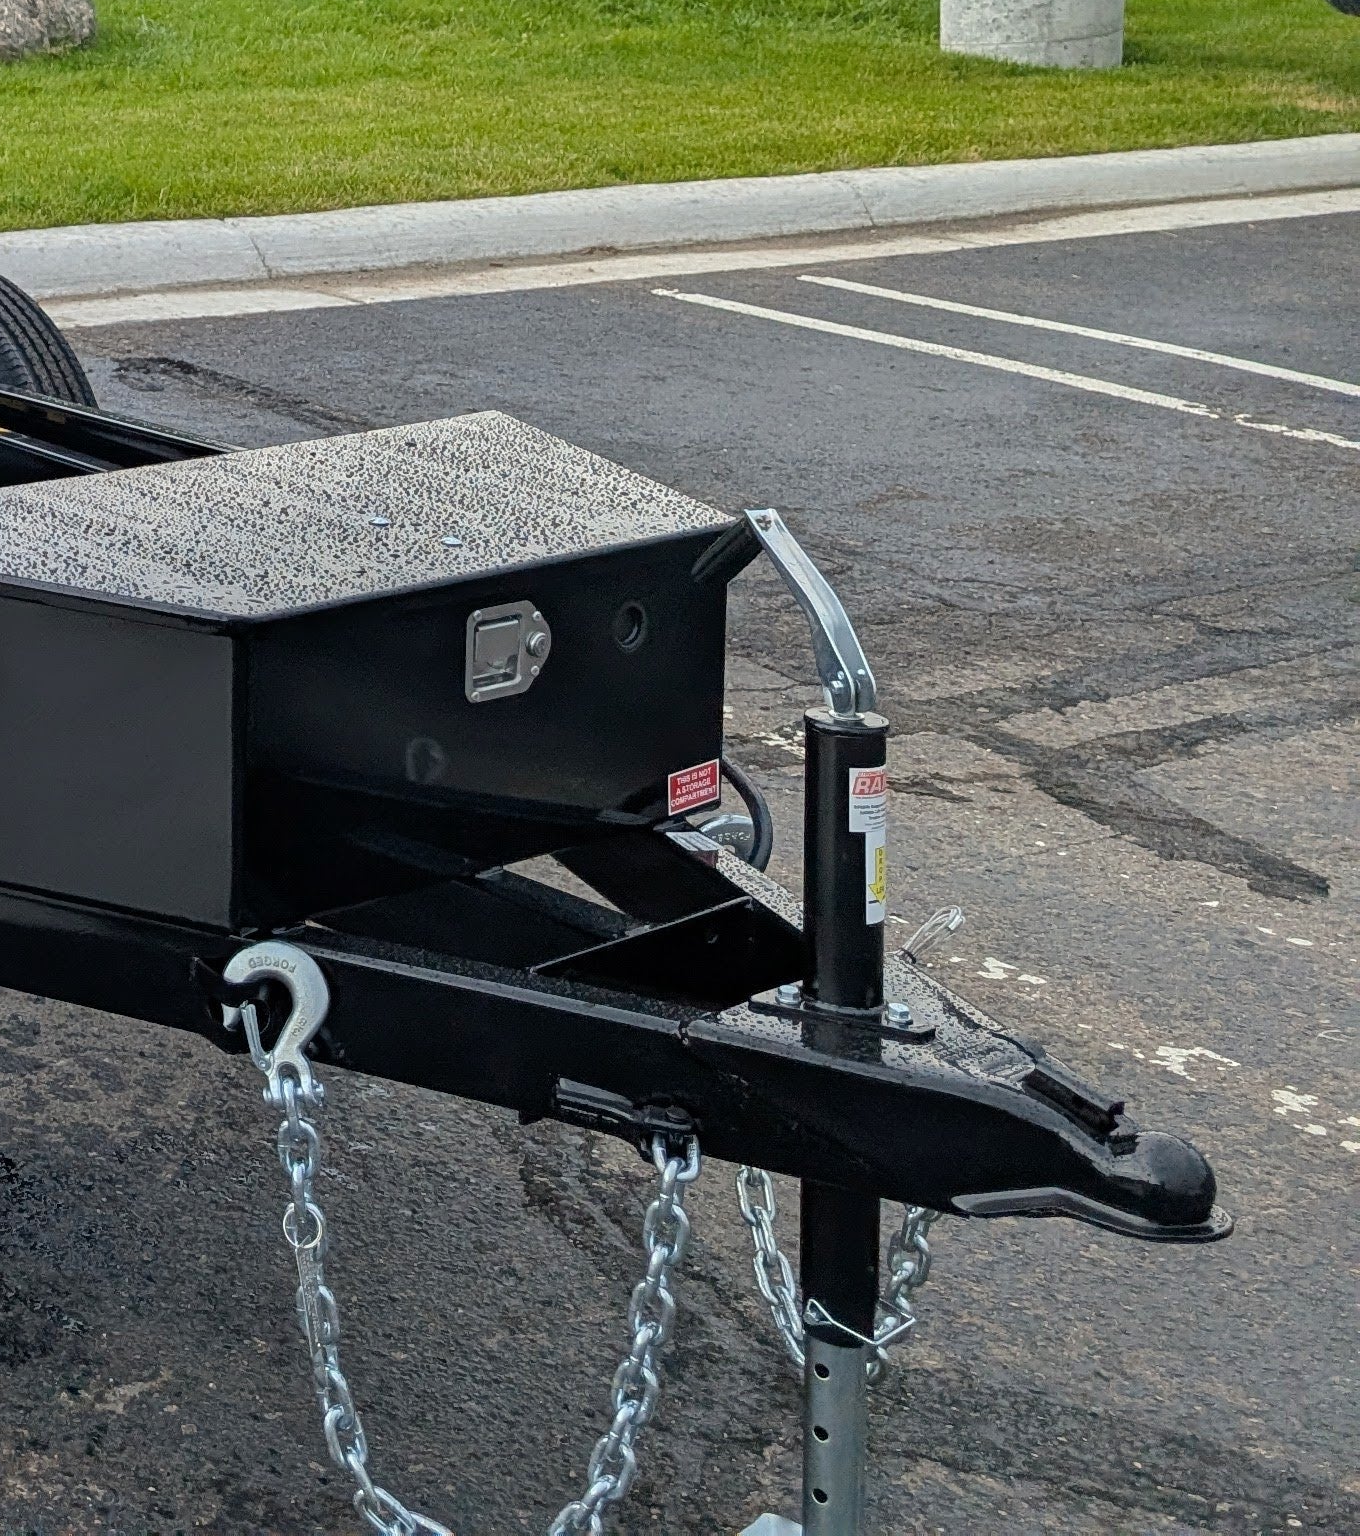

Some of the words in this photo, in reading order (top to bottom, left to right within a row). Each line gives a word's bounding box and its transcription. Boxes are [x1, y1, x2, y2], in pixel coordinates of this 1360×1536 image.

[676, 775, 691, 785] THIS
[691, 771, 698, 781] IS
[698, 767, 712, 778] NOT
[854, 775, 886, 795] RA
[682, 777, 712, 794] STORAGE
[670, 785, 717, 808] COMPARTMENT
[249, 956, 296, 974] FORGED
